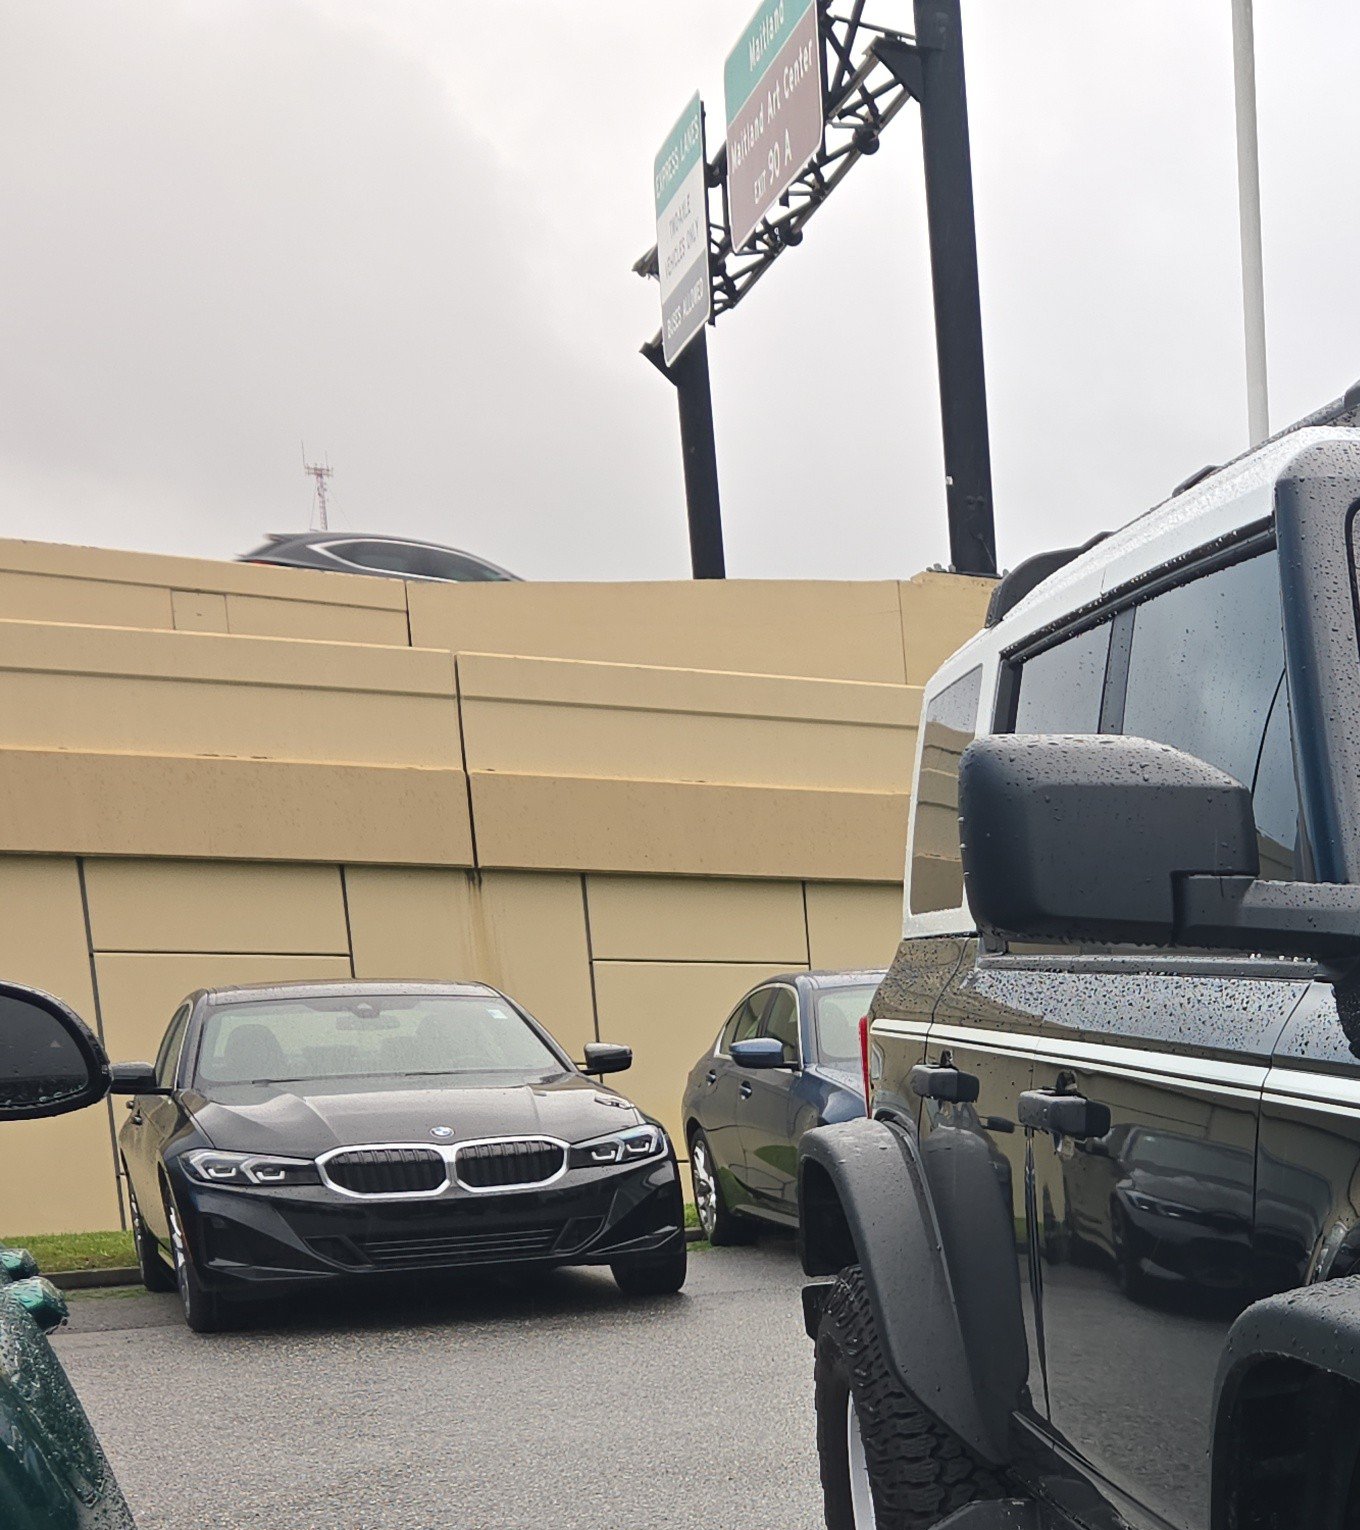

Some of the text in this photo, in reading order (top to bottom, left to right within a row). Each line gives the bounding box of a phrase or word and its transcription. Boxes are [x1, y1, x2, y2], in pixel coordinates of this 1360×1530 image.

[748, 0, 784, 72] Maitland
[731, 38, 813, 174] Maitland Art Center
[656, 113, 700, 199] EXPRESS LANES
[754, 128, 793, 205] EXIT 90 A
